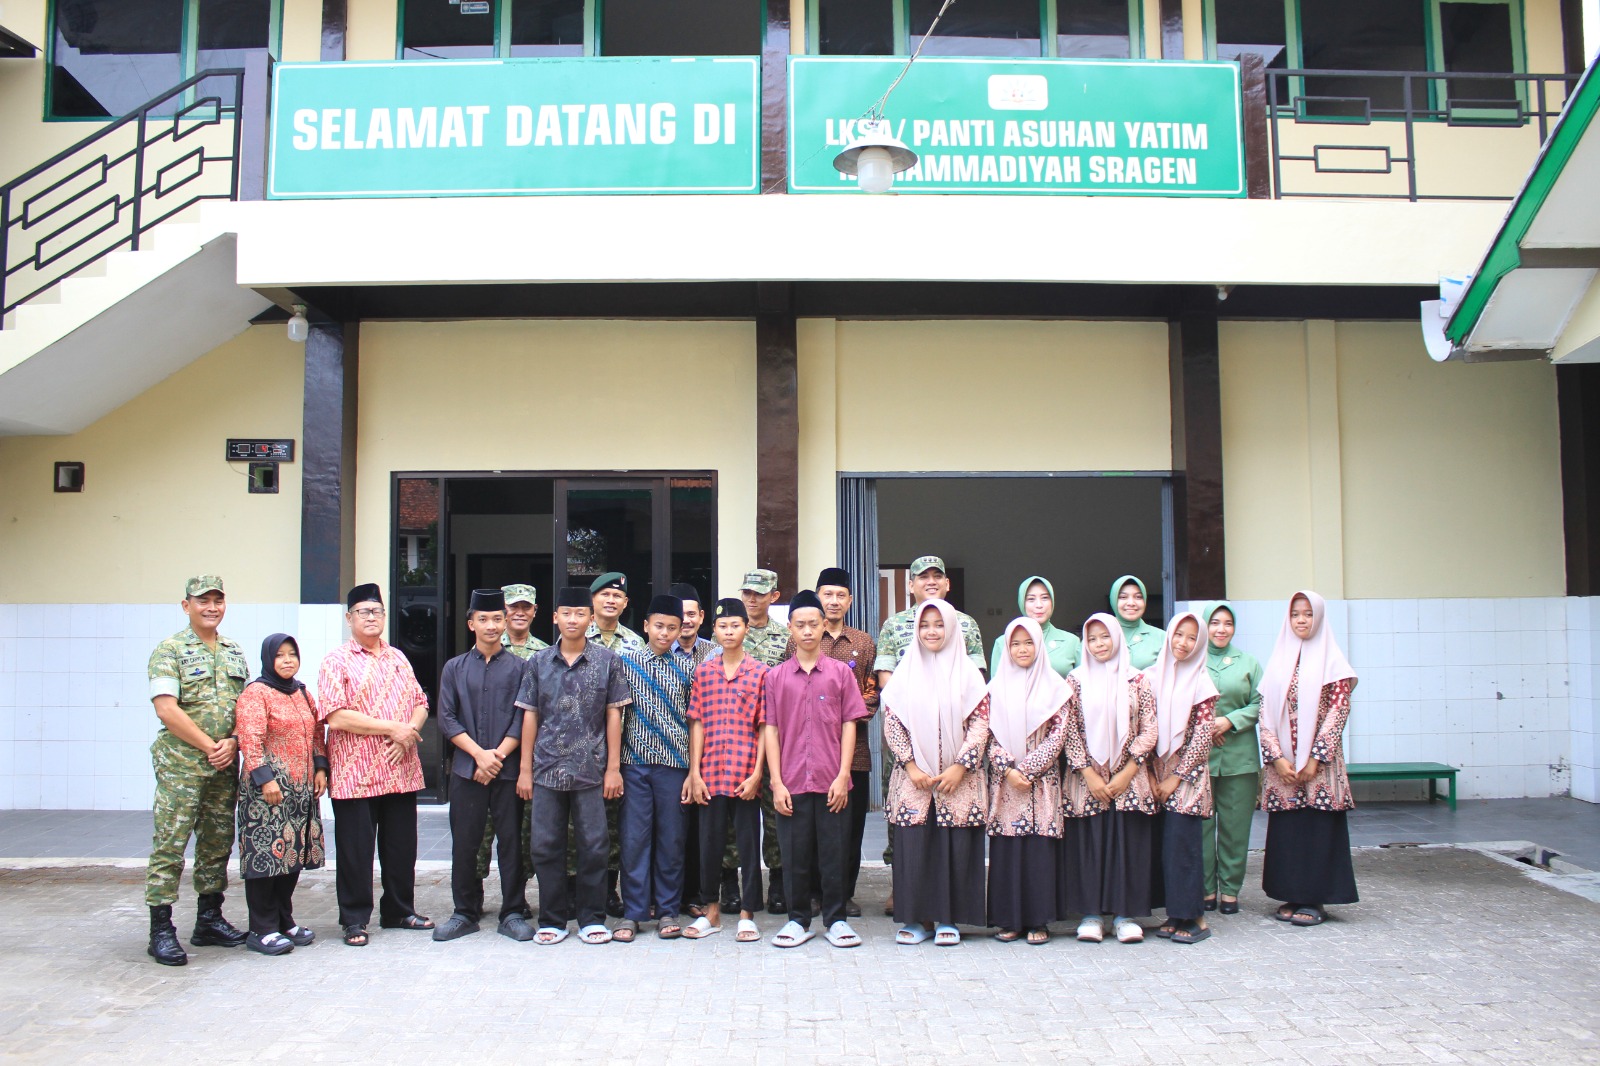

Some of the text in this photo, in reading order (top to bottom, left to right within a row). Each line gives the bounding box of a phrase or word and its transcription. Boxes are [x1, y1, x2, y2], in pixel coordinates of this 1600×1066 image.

[293, 103, 736, 150] SELAMAT DATANG DI
[914, 119, 994, 146] PANTI
[1004, 121, 1115, 147] ASUHAN
[1124, 122, 1208, 149] YATIM
[839, 154, 1196, 184] AMMADIYAH SRAGEN
